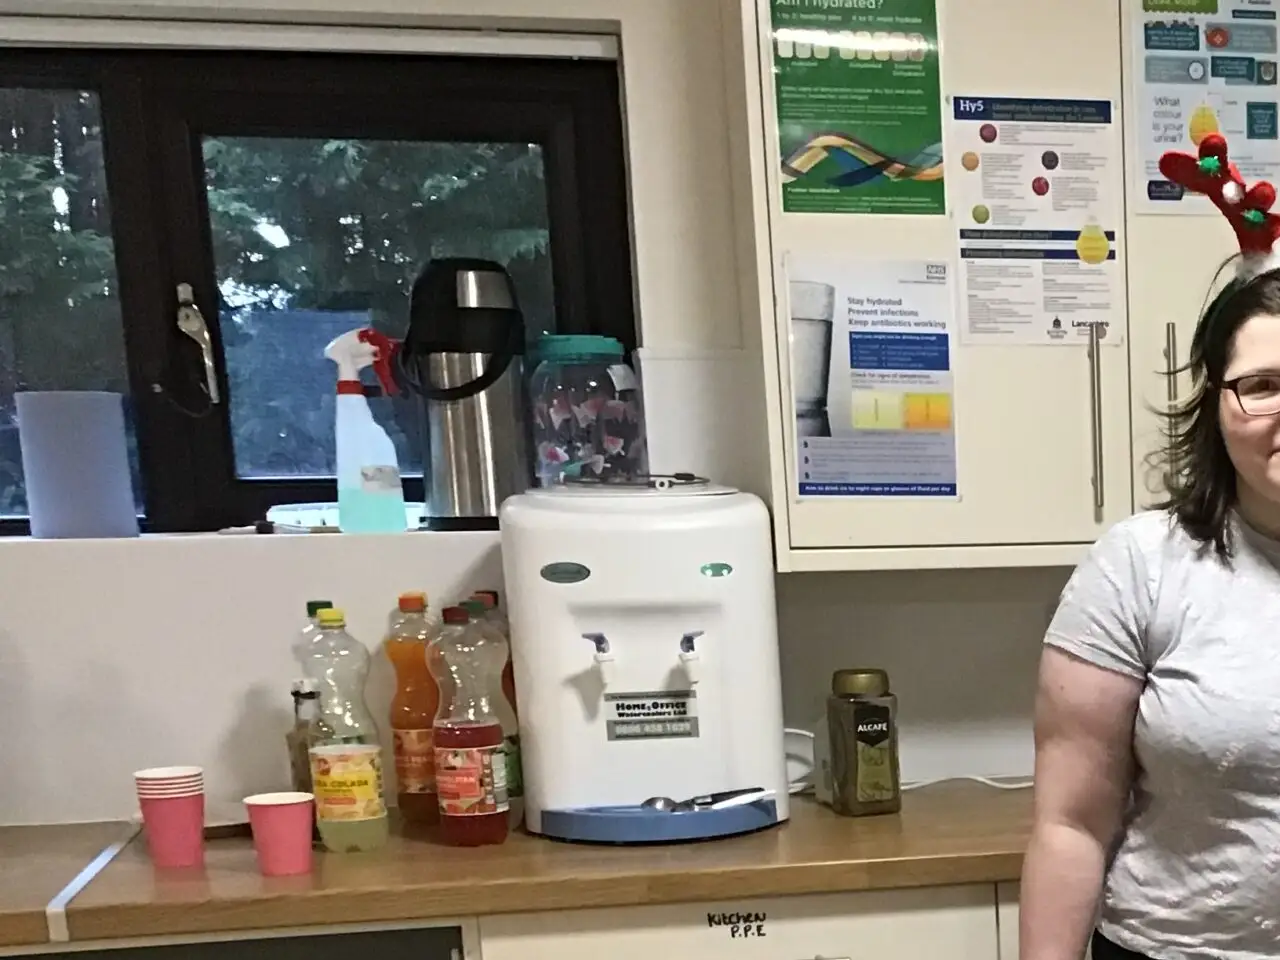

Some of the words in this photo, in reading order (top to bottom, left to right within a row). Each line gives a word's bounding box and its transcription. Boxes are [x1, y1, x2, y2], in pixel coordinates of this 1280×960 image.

[959, 100, 984, 113] Hy5
[1154, 97, 1180, 106] What
[847, 297, 864, 306] Stay
[866, 297, 902, 306] hydrated
[848, 307, 878, 316] Prevent
[880, 308, 919, 317] infections
[848, 319, 869, 327] Keep
[871, 319, 911, 327] antibiotics
[914, 320, 946, 329] working
[731, 925, 766, 938] P.P.E
